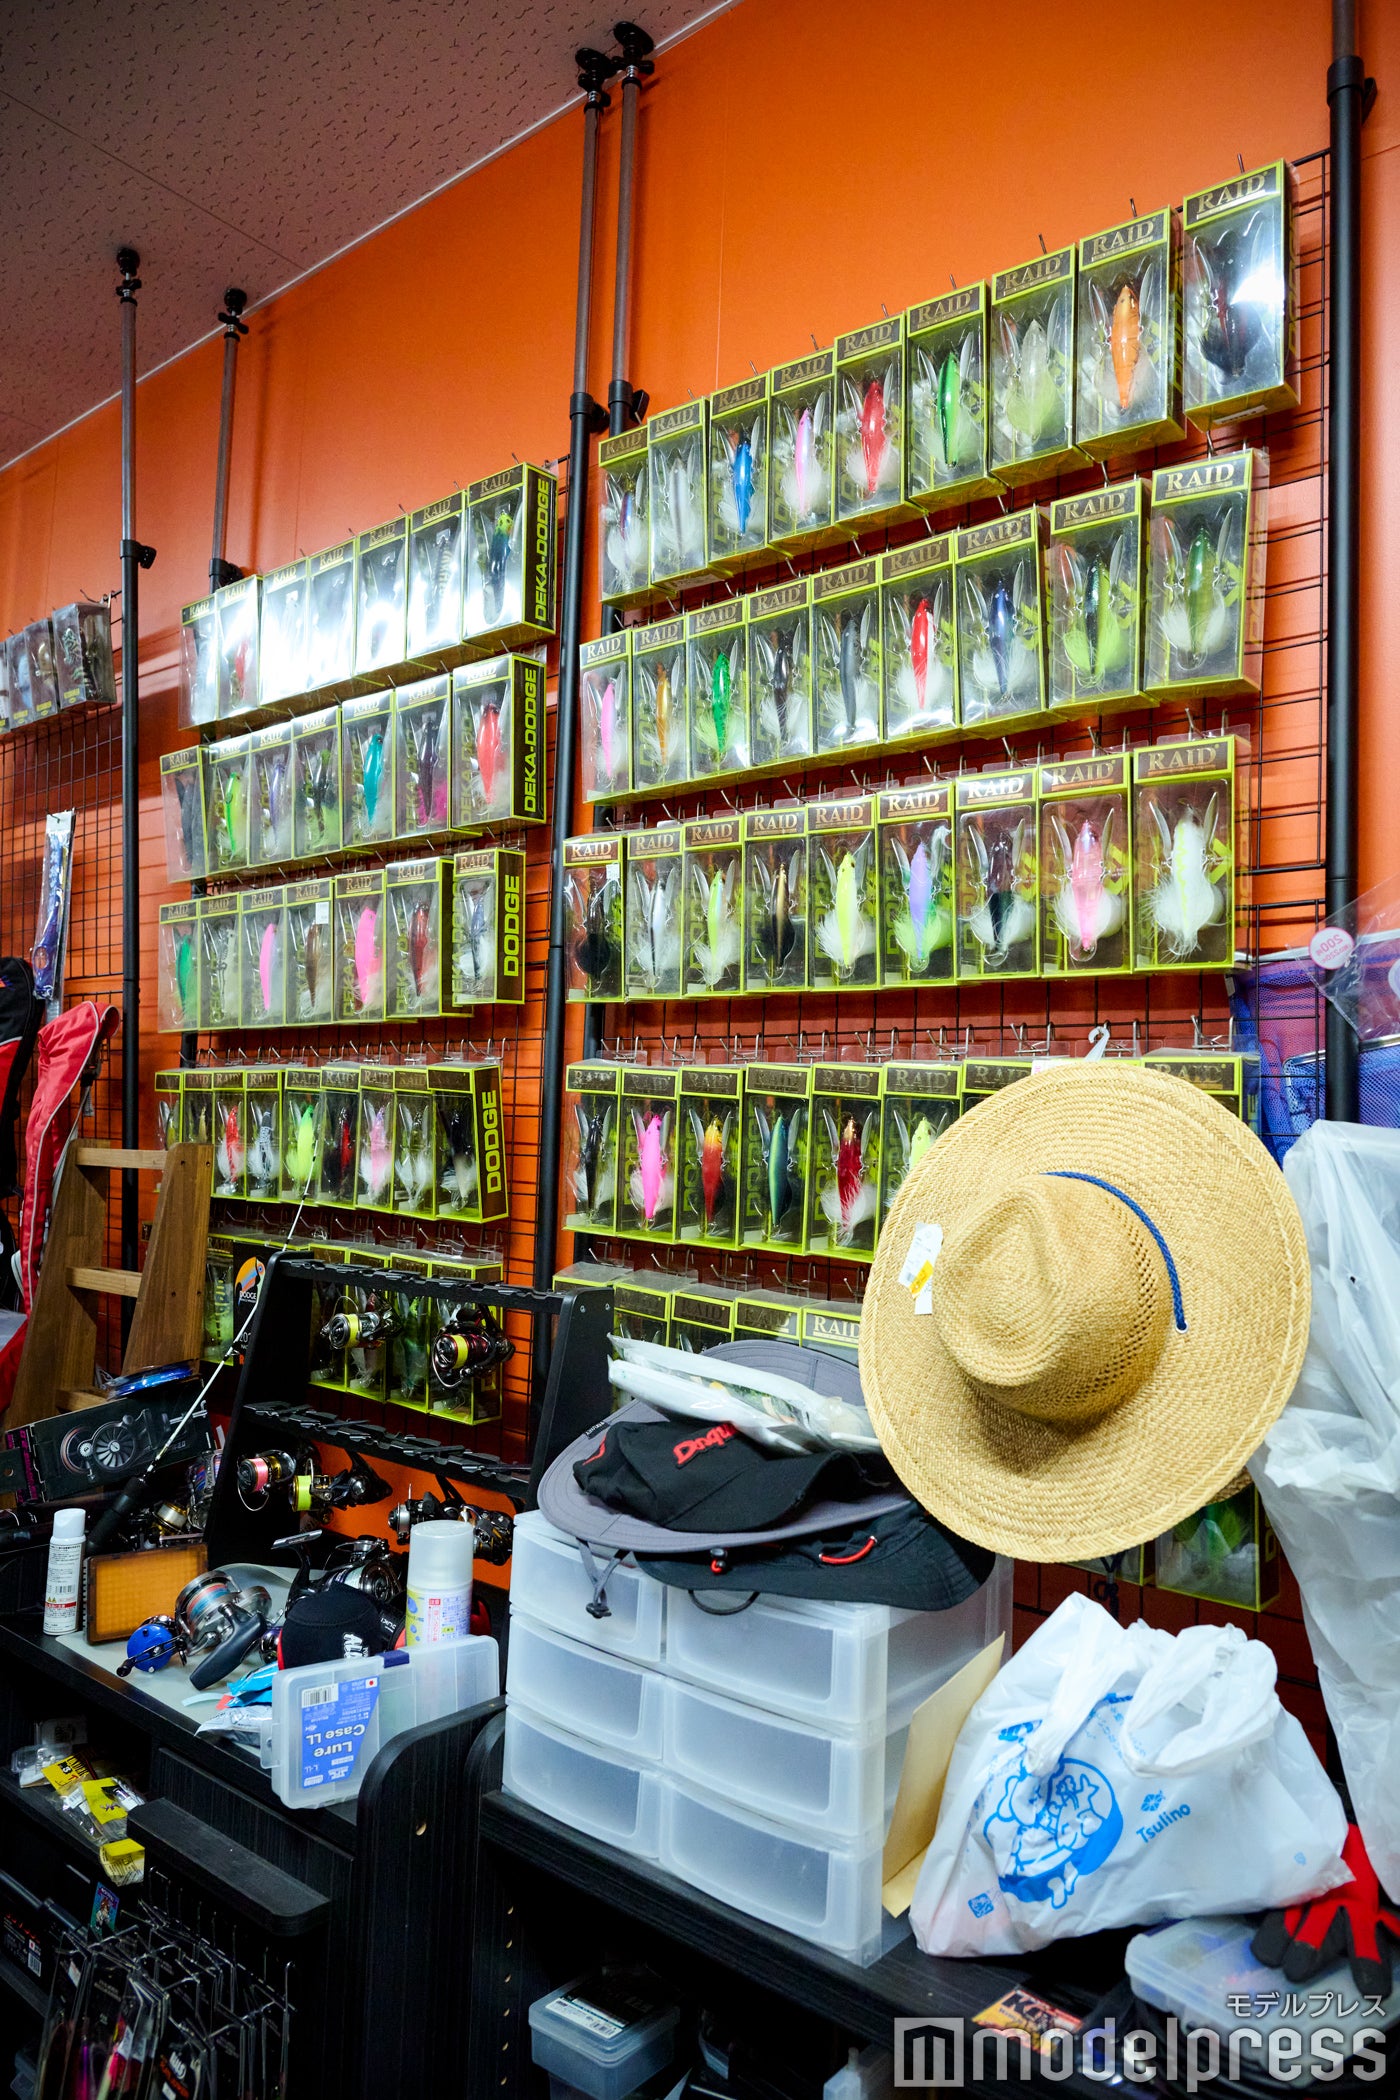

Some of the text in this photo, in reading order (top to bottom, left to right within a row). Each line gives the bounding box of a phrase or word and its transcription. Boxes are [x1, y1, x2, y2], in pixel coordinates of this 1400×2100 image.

[1197, 173, 1266, 214] RAID
[1092, 220, 1155, 256] RAID
[1004, 256, 1062, 291] RAID
[918, 292, 971, 324] RAID
[845, 324, 892, 349] RAID
[780, 358, 827, 383] RAID
[718, 384, 760, 409] RAID
[655, 409, 694, 433] RAID
[1166, 463, 1235, 493] RAID
[1064, 492, 1126, 521] RAID
[967, 519, 1022, 549] RAID
[535, 479, 549, 621] DEKA-DODGE
[890, 543, 942, 571] RAID
[822, 566, 870, 592] RAID
[758, 588, 801, 612] RAID
[695, 605, 736, 629] RAID
[641, 625, 679, 645] RAID
[587, 639, 620, 660] RAID
[524, 668, 537, 812] DEKA-DODGE
[169, 753, 190, 766] RAID
[1149, 747, 1217, 771] RAID
[1052, 763, 1114, 786] RAID
[968, 777, 1024, 799] RAID
[888, 791, 940, 811] RAID
[754, 814, 798, 831] RAID
[815, 805, 864, 823] RAID
[636, 834, 674, 851] RAID
[692, 823, 733, 842] RAID
[572, 842, 611, 857] RAID
[398, 864, 426, 879] RAID
[460, 855, 491, 870] RAID
[296, 885, 319, 899] RAID
[346, 876, 373, 890] RAID
[168, 903, 188, 917] RAID
[208, 897, 230, 912] RAID
[252, 892, 274, 907] RAID
[504, 871, 520, 976] DODGE
[896, 1069, 951, 1088] RAID
[482, 1090, 502, 1193] DODGE
[305, 1723, 366, 1745] Case LL
[313, 1740, 353, 1758] Lure
[1136, 1802, 1191, 1844] Tsulino
